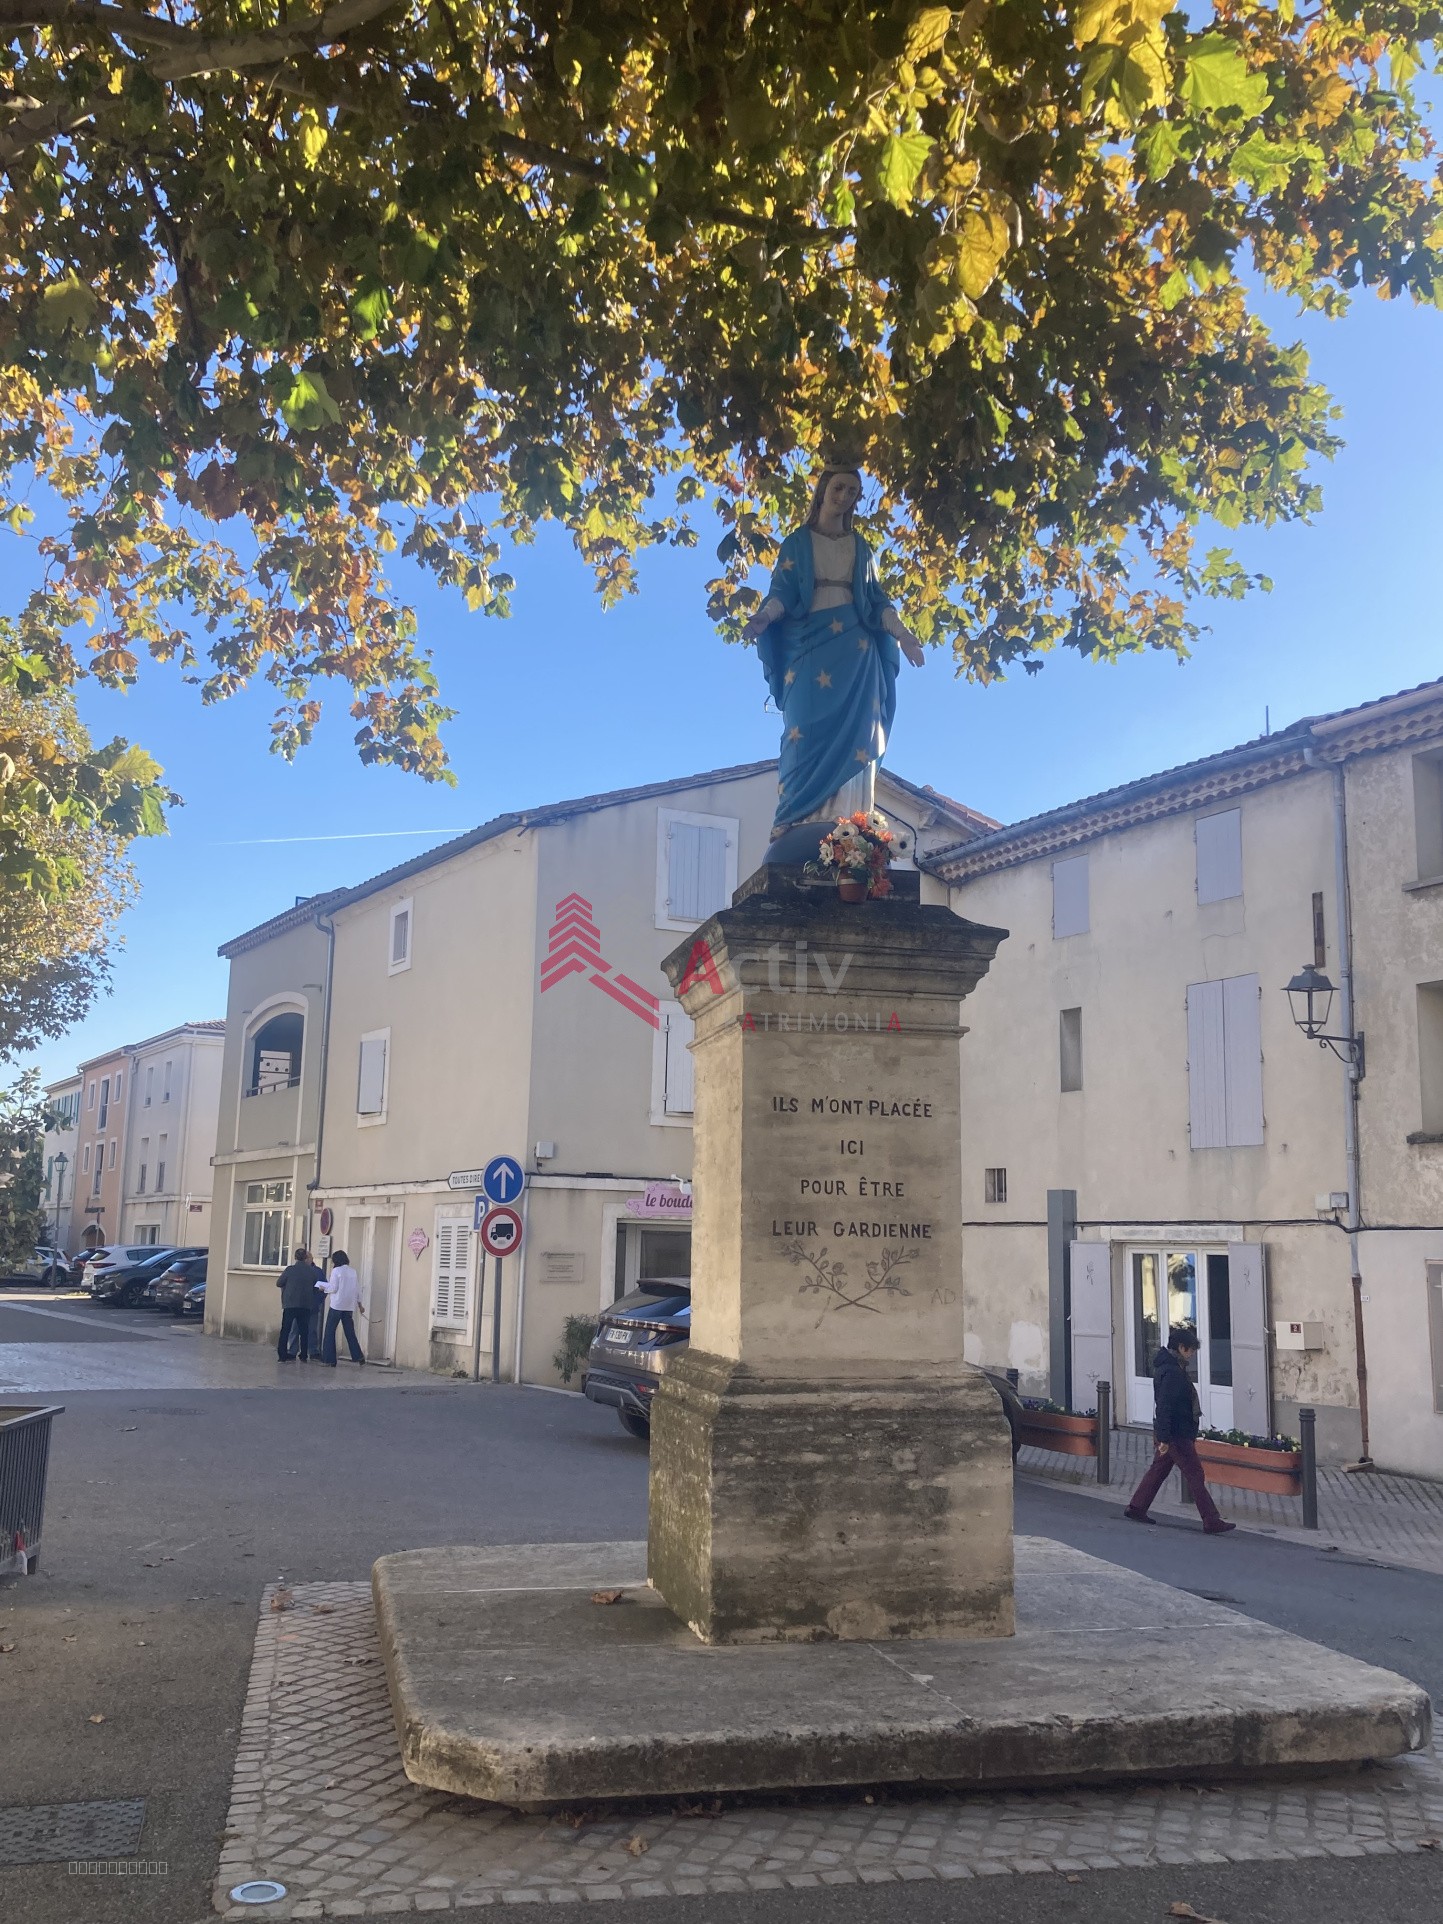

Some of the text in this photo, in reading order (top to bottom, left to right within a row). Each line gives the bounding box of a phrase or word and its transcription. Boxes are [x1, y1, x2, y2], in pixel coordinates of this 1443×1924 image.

[772, 1096, 933, 1118] ILS M'ONT PLACÉE
[840, 1139, 865, 1156] ICI
[452, 1175, 469, 1185] TOUTES
[800, 1176, 905, 1197] POUR ÊTRE
[645, 1193, 657, 1207] le
[477, 1201, 486, 1224] P
[772, 1220, 932, 1239] LEUR GARDIENNE
